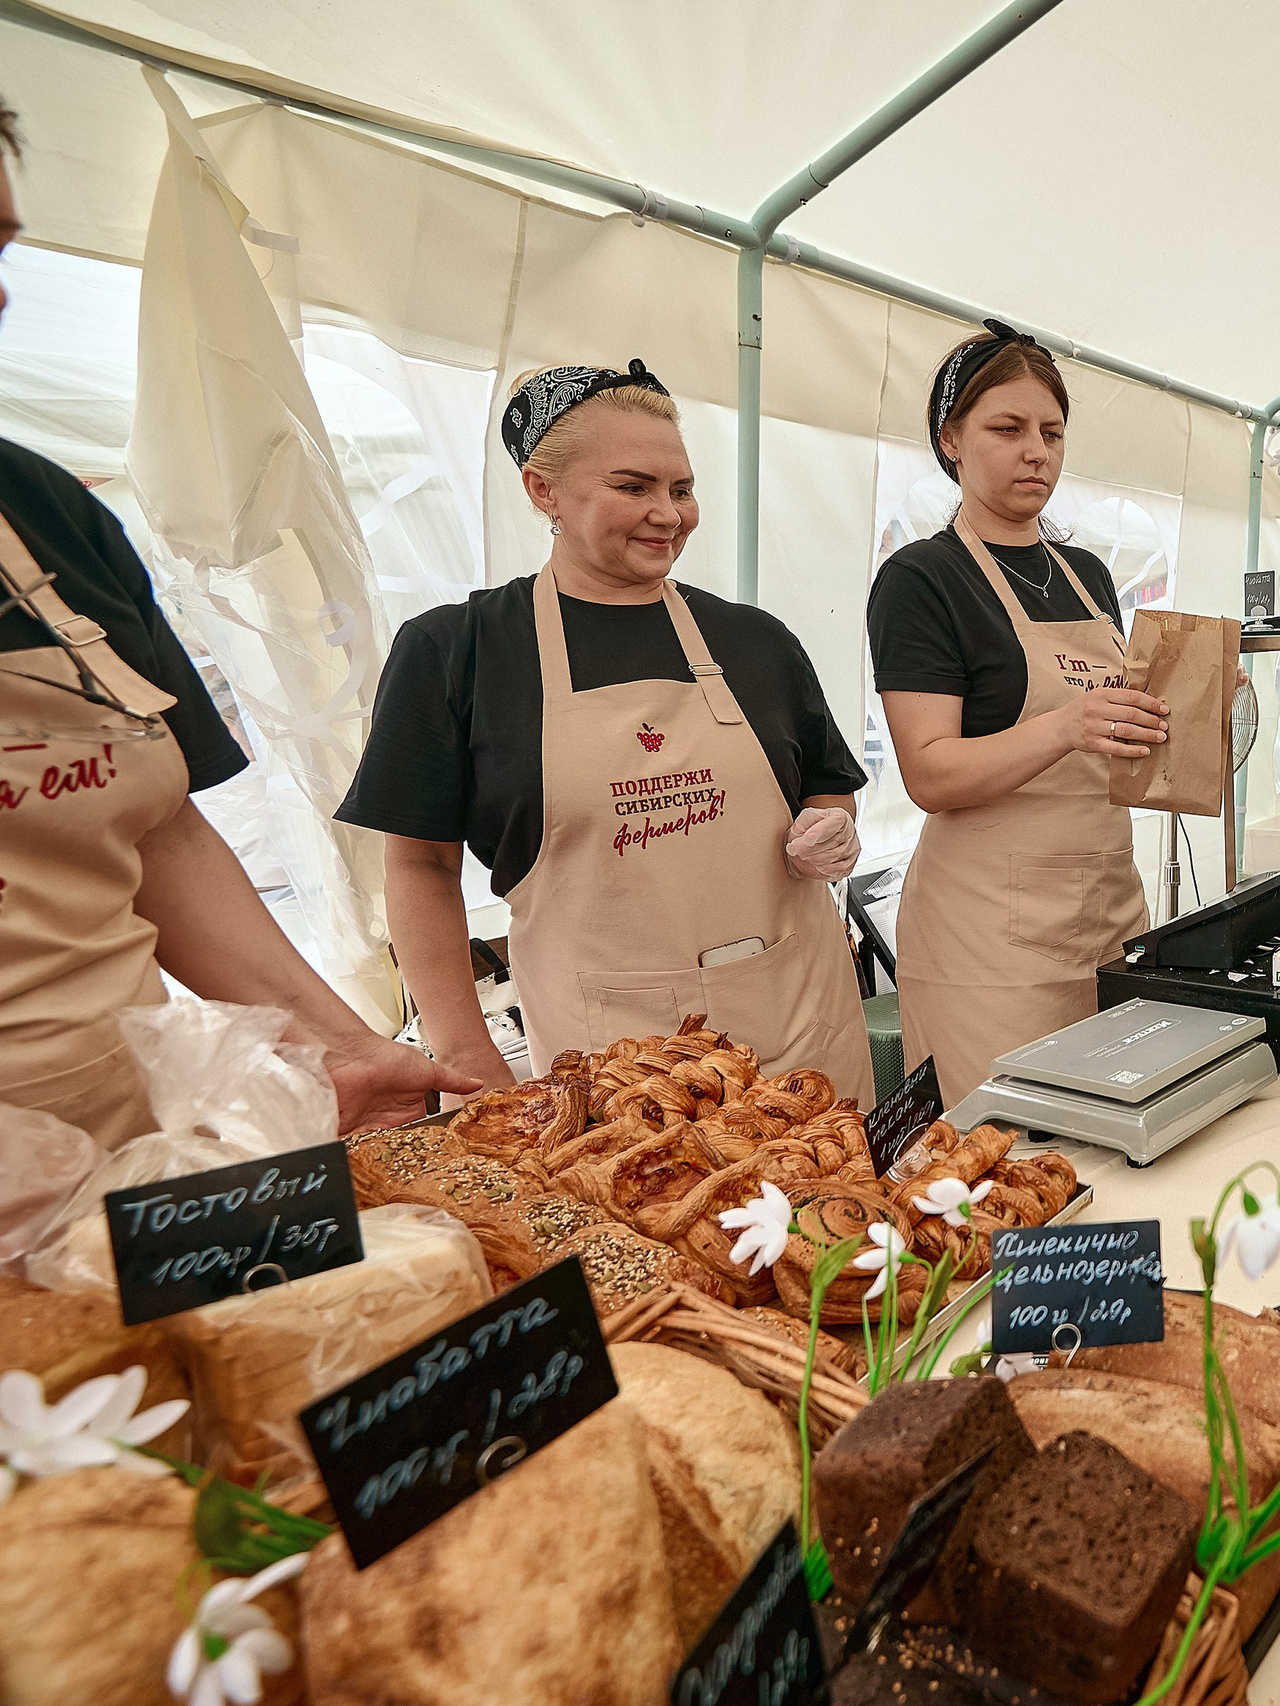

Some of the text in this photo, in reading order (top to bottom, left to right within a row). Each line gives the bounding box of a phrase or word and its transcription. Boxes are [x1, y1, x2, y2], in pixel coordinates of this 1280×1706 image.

[609, 768, 715, 798] ПОДДЕРЖИ
[614, 787, 717, 816] СИБИРСКИХ
[612, 789, 727, 857] фермеров!
[119, 1163, 329, 1239] Тостовый
